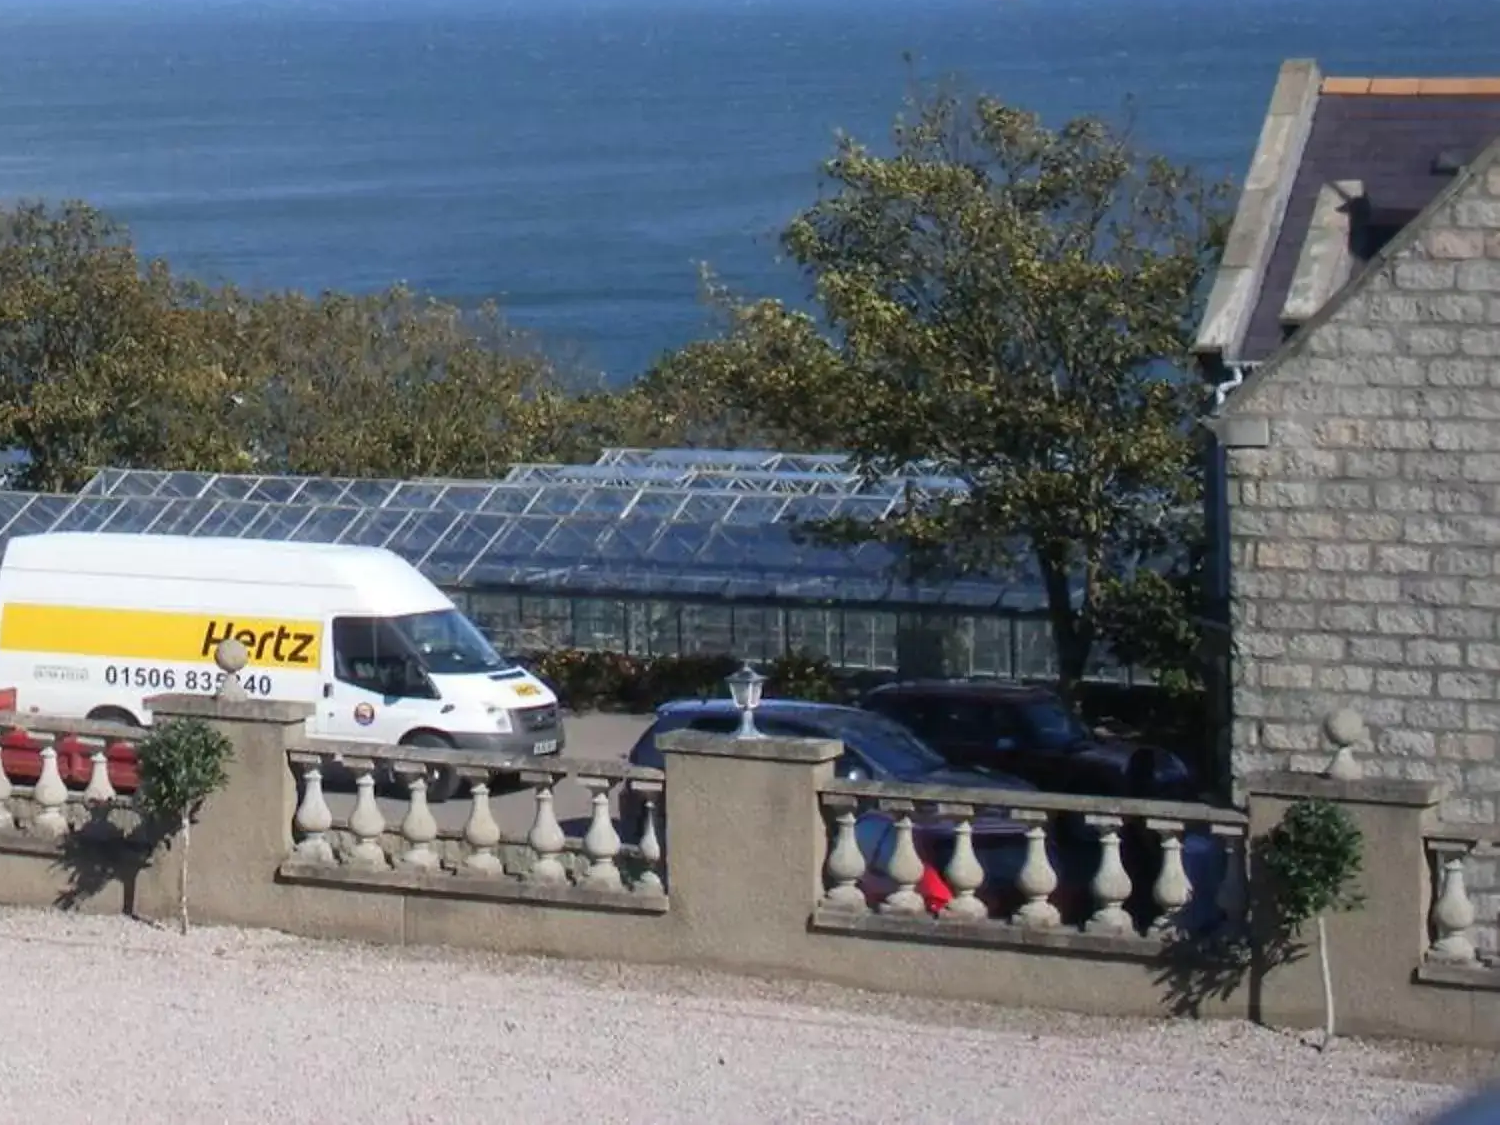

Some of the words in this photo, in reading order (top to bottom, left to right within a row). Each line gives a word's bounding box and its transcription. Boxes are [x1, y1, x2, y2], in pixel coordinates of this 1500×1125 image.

[202, 621, 314, 663] Hertz
[105, 665, 175, 688] 01506
[185, 670, 272, 695] 83540
